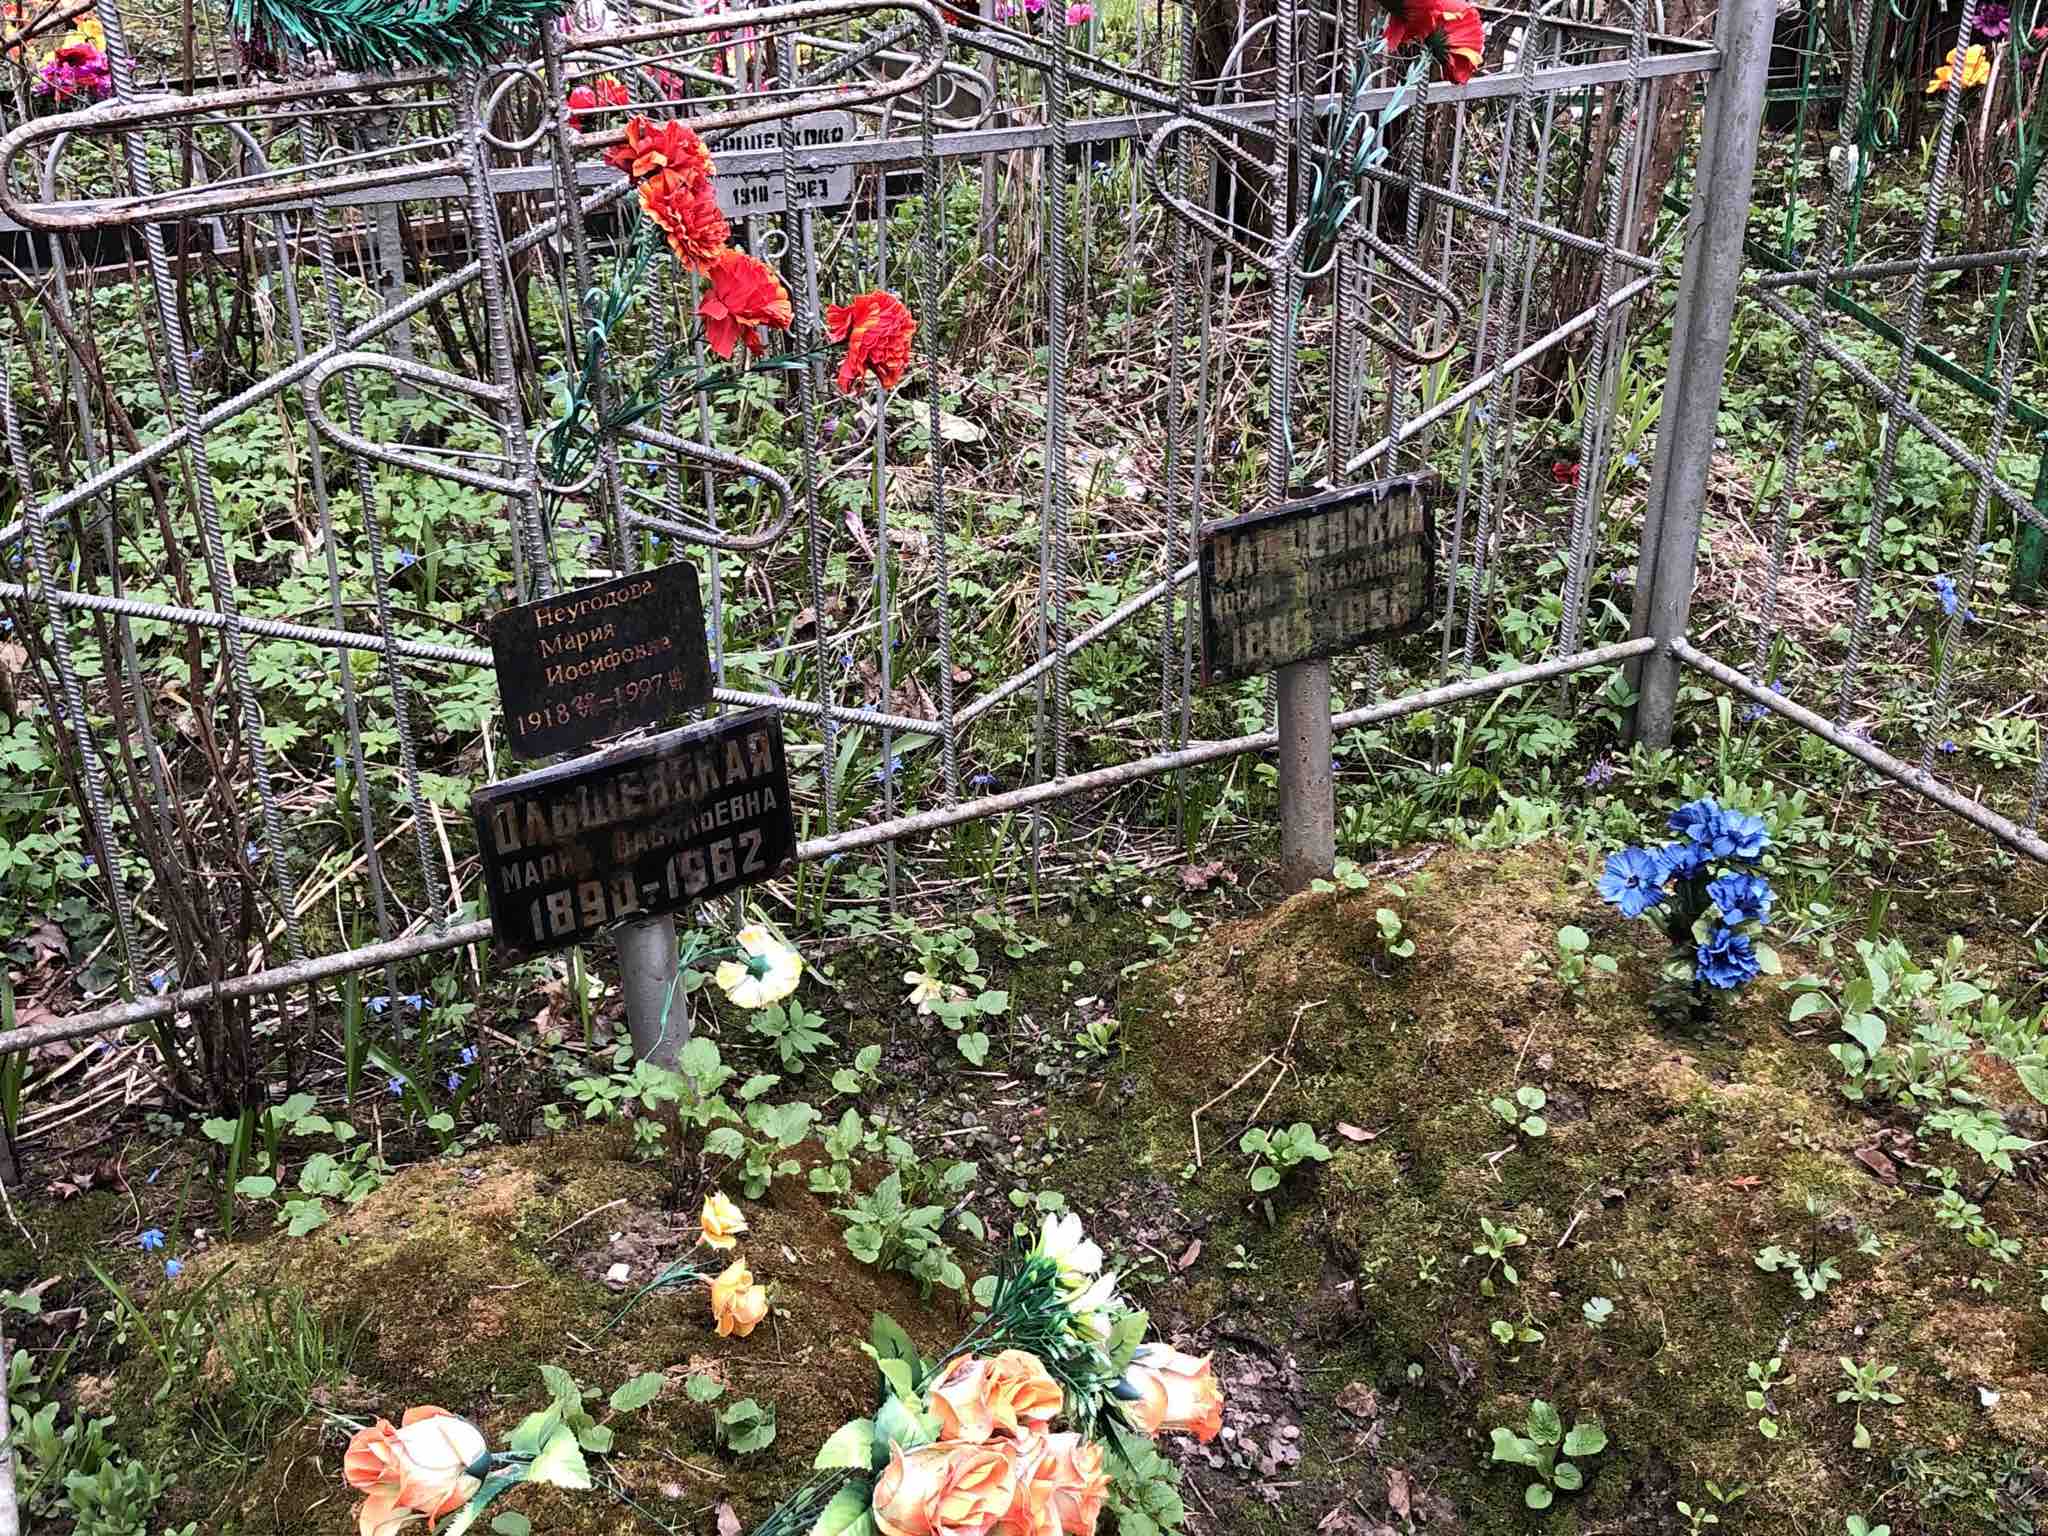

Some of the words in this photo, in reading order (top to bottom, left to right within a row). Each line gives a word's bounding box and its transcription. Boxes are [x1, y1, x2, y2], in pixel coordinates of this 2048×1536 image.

[533, 580, 653, 628] Неугодова
[538, 623, 616, 659] Мария
[517, 703, 570, 736] 1918
